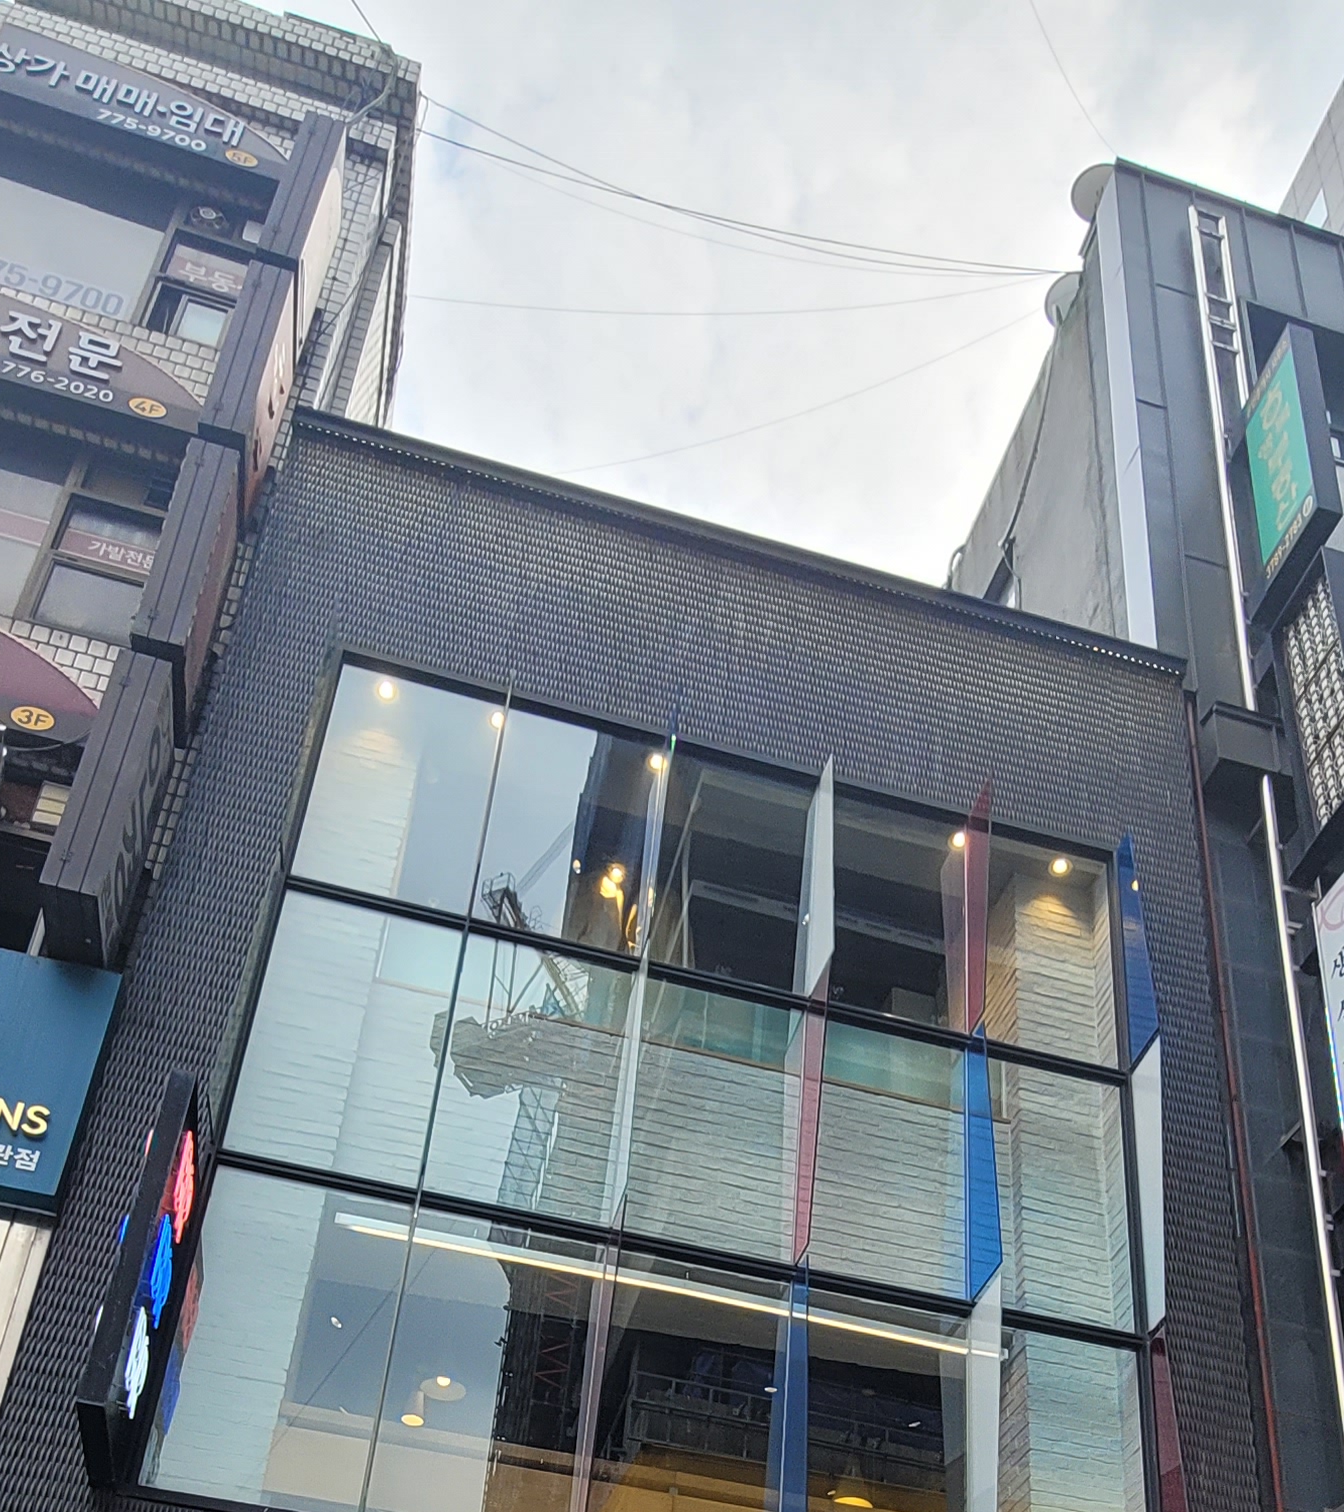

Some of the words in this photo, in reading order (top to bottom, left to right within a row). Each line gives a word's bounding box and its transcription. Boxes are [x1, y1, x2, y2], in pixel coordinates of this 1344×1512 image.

[96, 109, 207, 151] 775-9700
[1, 360, 115, 402] 776-2020
[133, 399, 163, 416] 4F
[16, 708, 51, 729] 3F
